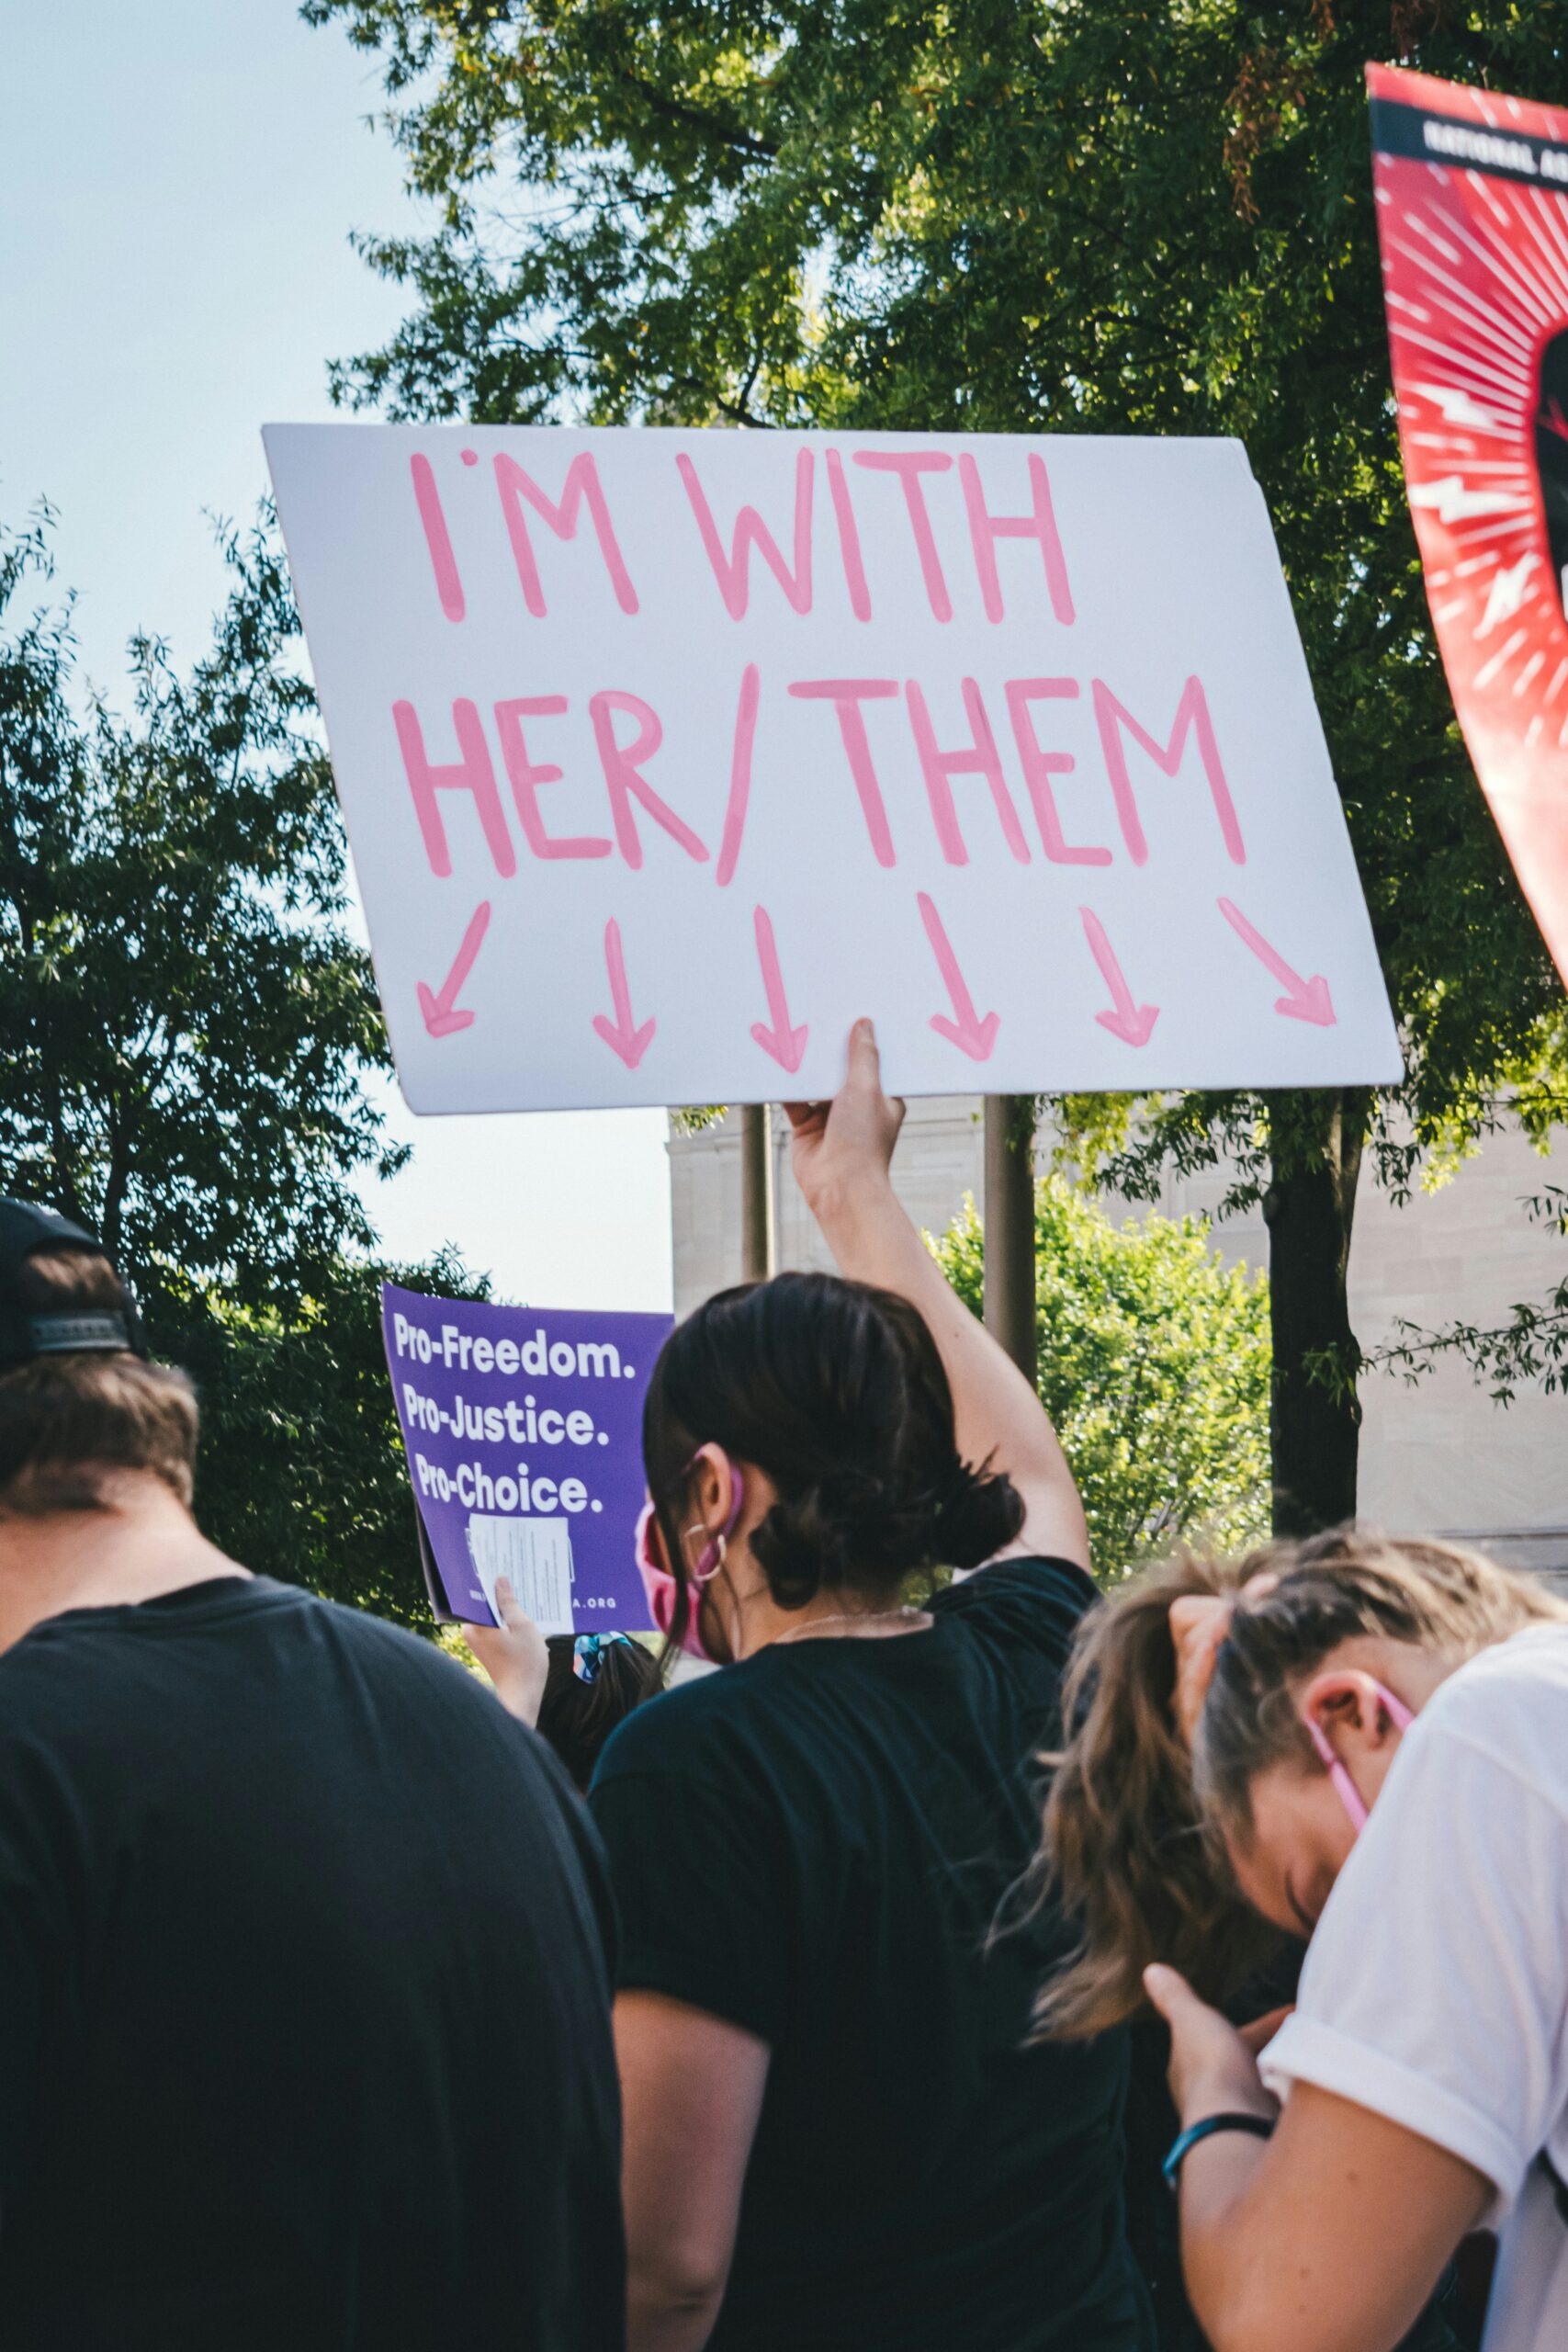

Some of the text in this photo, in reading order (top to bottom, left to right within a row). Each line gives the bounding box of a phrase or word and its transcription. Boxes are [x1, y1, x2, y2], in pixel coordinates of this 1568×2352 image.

[411, 447, 1076, 626] I'M WITH
[393, 1313, 636, 1378] Pro-Freedom.
[402, 1384, 609, 1445] Pro-Justice.
[415, 1453, 603, 1512] Pro-Choice.
[572, 1597, 616, 1609] A.ORG
